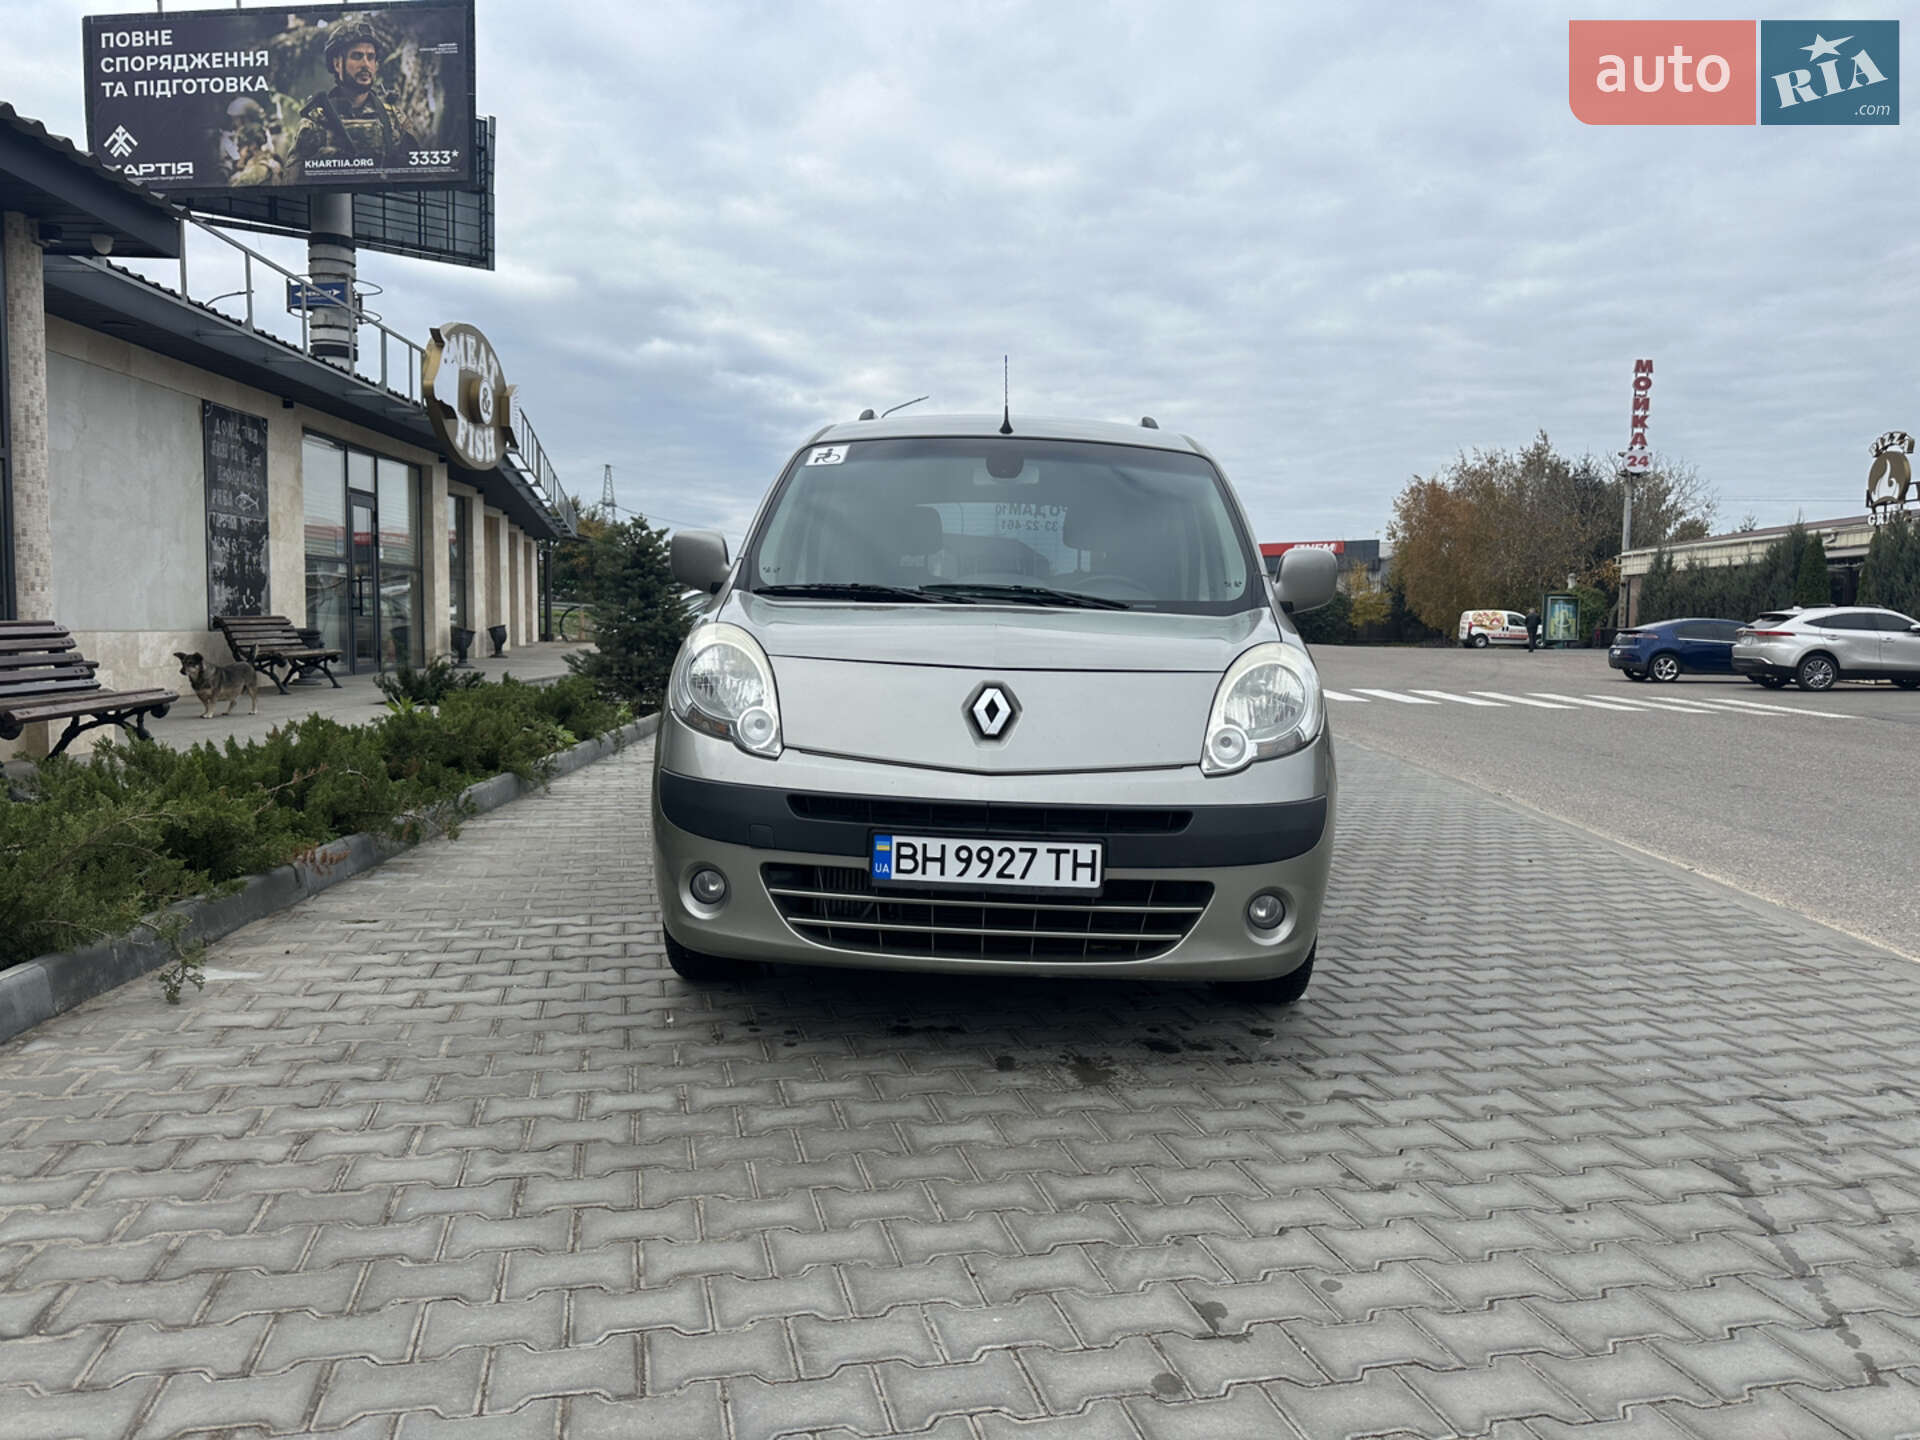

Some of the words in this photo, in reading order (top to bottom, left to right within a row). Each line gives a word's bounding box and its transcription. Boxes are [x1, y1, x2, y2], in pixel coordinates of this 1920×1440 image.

[100, 29, 173, 48] ПОВНЕ
[100, 50, 269, 73] СПОРЯДЖЕННЯ
[101, 81, 128, 98] ТА
[134, 75, 269, 99] ПІДГОТОВКА
[115, 162, 194, 176] АРТІЯ
[304, 158, 374, 169] KHARTIIA.ORG
[446, 332, 499, 391] MEAT
[455, 411, 497, 464] FISH
[1627, 455, 1649, 467] 24
[875, 863, 890, 874] UA
[895, 841, 946, 877] BH
[954, 844, 1038, 881] 9927
[1046, 848, 1097, 882] TH
